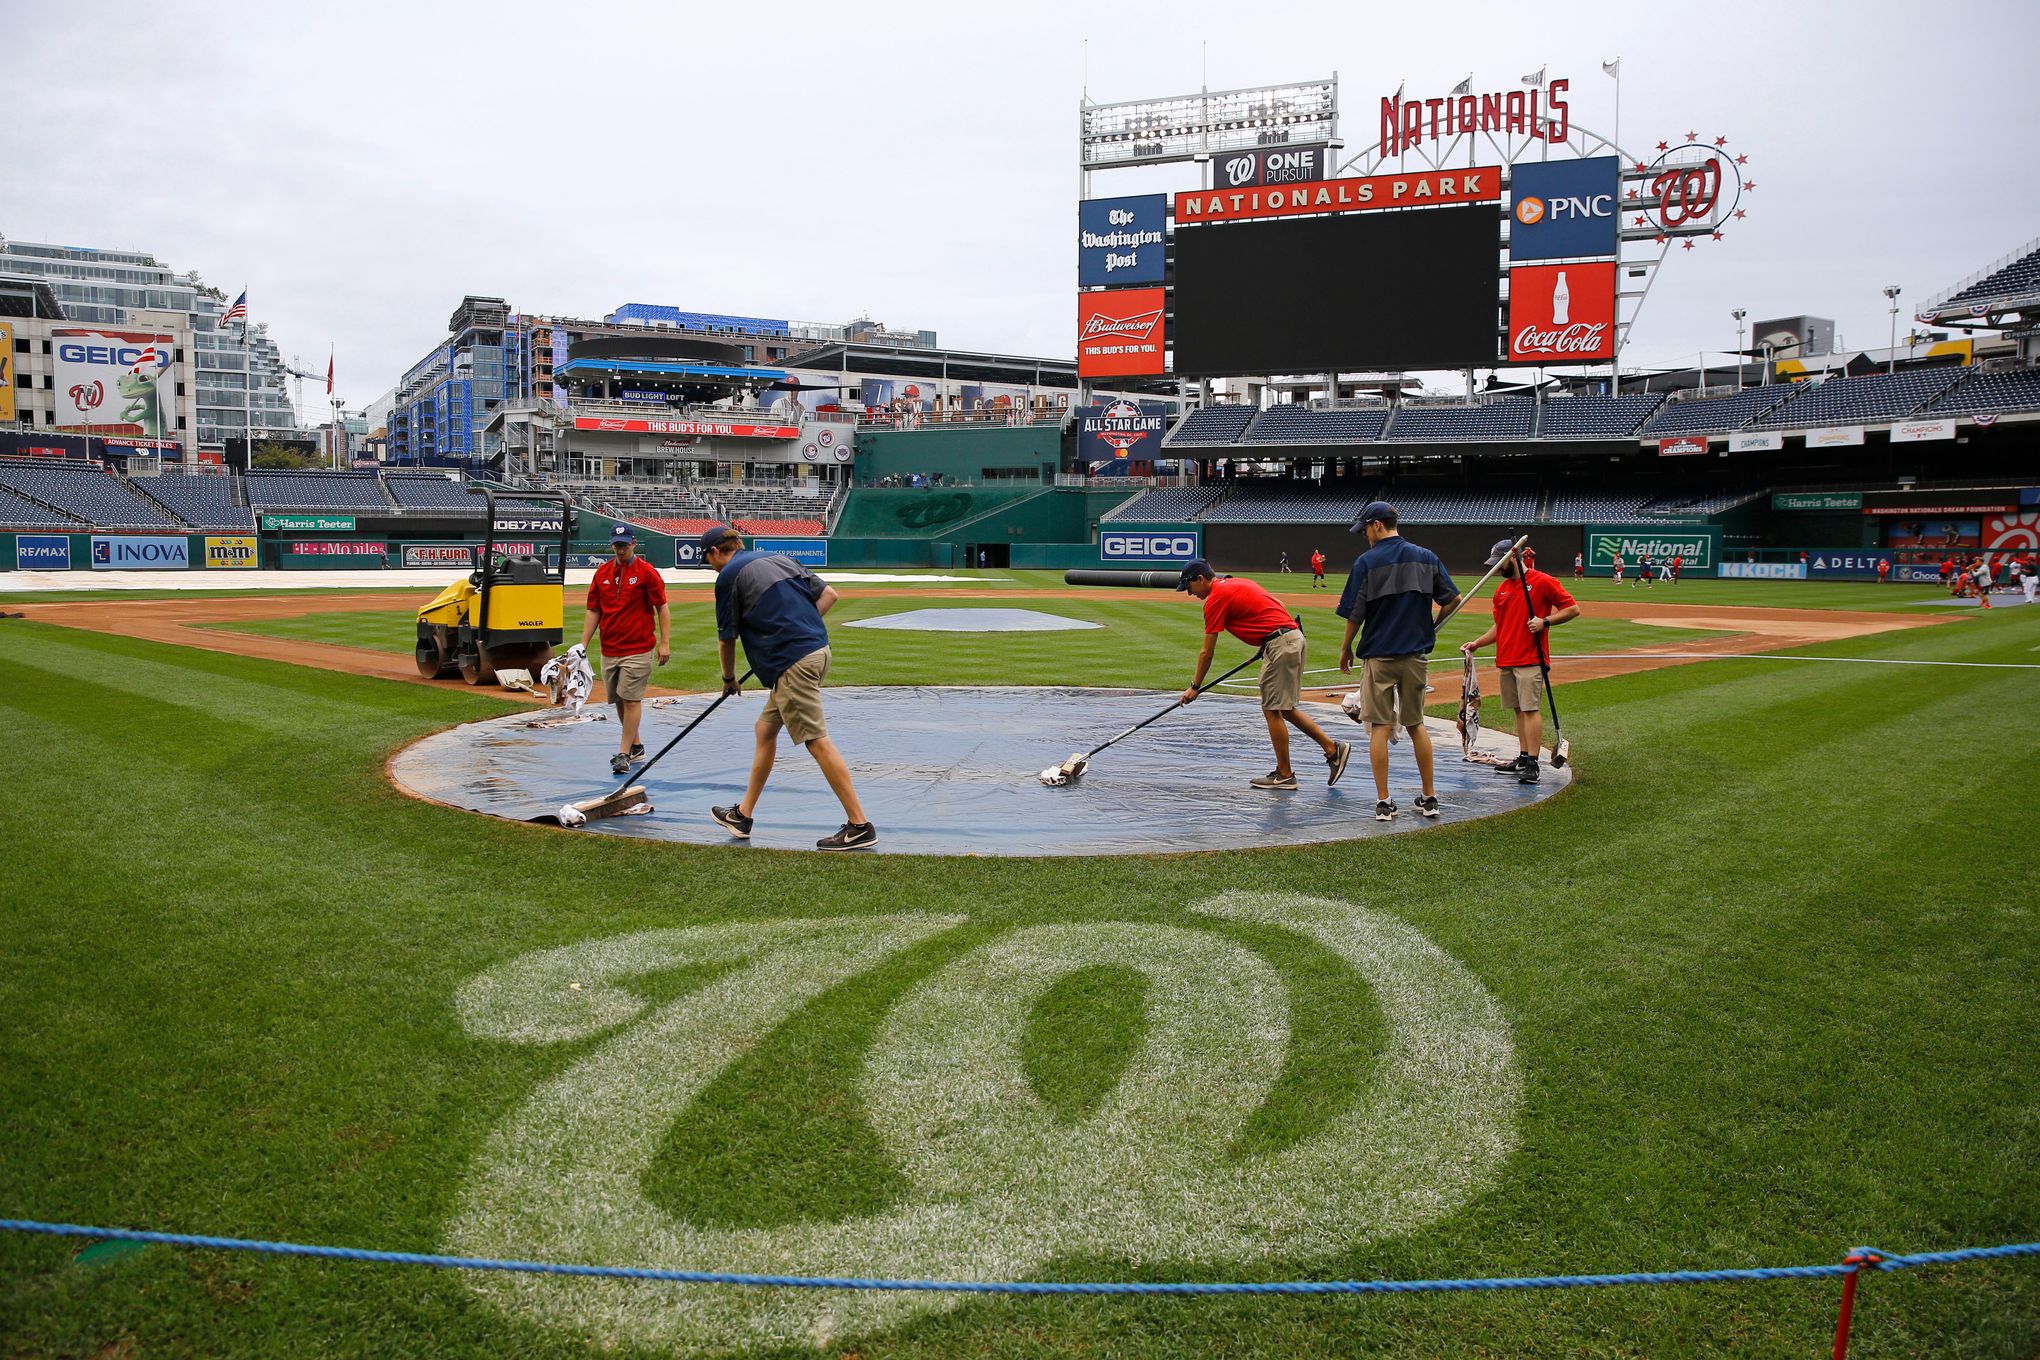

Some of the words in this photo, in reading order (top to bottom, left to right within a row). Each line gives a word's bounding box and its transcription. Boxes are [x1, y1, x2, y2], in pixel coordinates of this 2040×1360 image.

[1380, 78, 1569, 158] NATIONALS
[1266, 151, 1314, 170] ONE
[1266, 167, 1314, 183] PURSUIT
[1186, 184, 1374, 216] NATIONALS
[1393, 175, 1481, 199] PARK
[1548, 195, 1612, 220] PNC
[1108, 209, 1135, 226] The
[1082, 229, 1163, 249] Washington
[1105, 252, 1138, 272] Post
[1086, 318, 1155, 334] Budweiser
[1513, 322, 1608, 355] Coca-Cola
[59, 344, 169, 368] GEICO
[1085, 347, 1101, 355] THIS
[1102, 346, 1124, 355] BUD'S
[1125, 345, 1139, 354] FOR
[1140, 344, 1158, 353] YOU.
[647, 422, 667, 432] THIS
[669, 422, 695, 433] BUD'S
[696, 423, 713, 433] FOR
[715, 424, 734, 434] YOU.
[1084, 419, 1103, 432] ALL
[1104, 418, 1131, 431] STAR
[1133, 418, 1161, 431] GAME
[107, 439, 135, 447] ADVANCE
[675, 446, 695, 454] HOUSE
[1662, 446, 1703, 454] CHAMPIONS
[1787, 498, 1821, 508] Harris
[1823, 497, 1859, 507] Teeter
[1966, 505, 2006, 513] FOUNDATION
[280, 519, 315, 528] Harris
[317, 519, 352, 529] Teeter
[531, 520, 563, 530] FAN
[19, 547, 66, 557] RE/MAX
[117, 544, 186, 561] INOVA
[1103, 537, 1194, 557] GEICO
[1620, 539, 1703, 557] National
[1831, 557, 1877, 569] DELT
